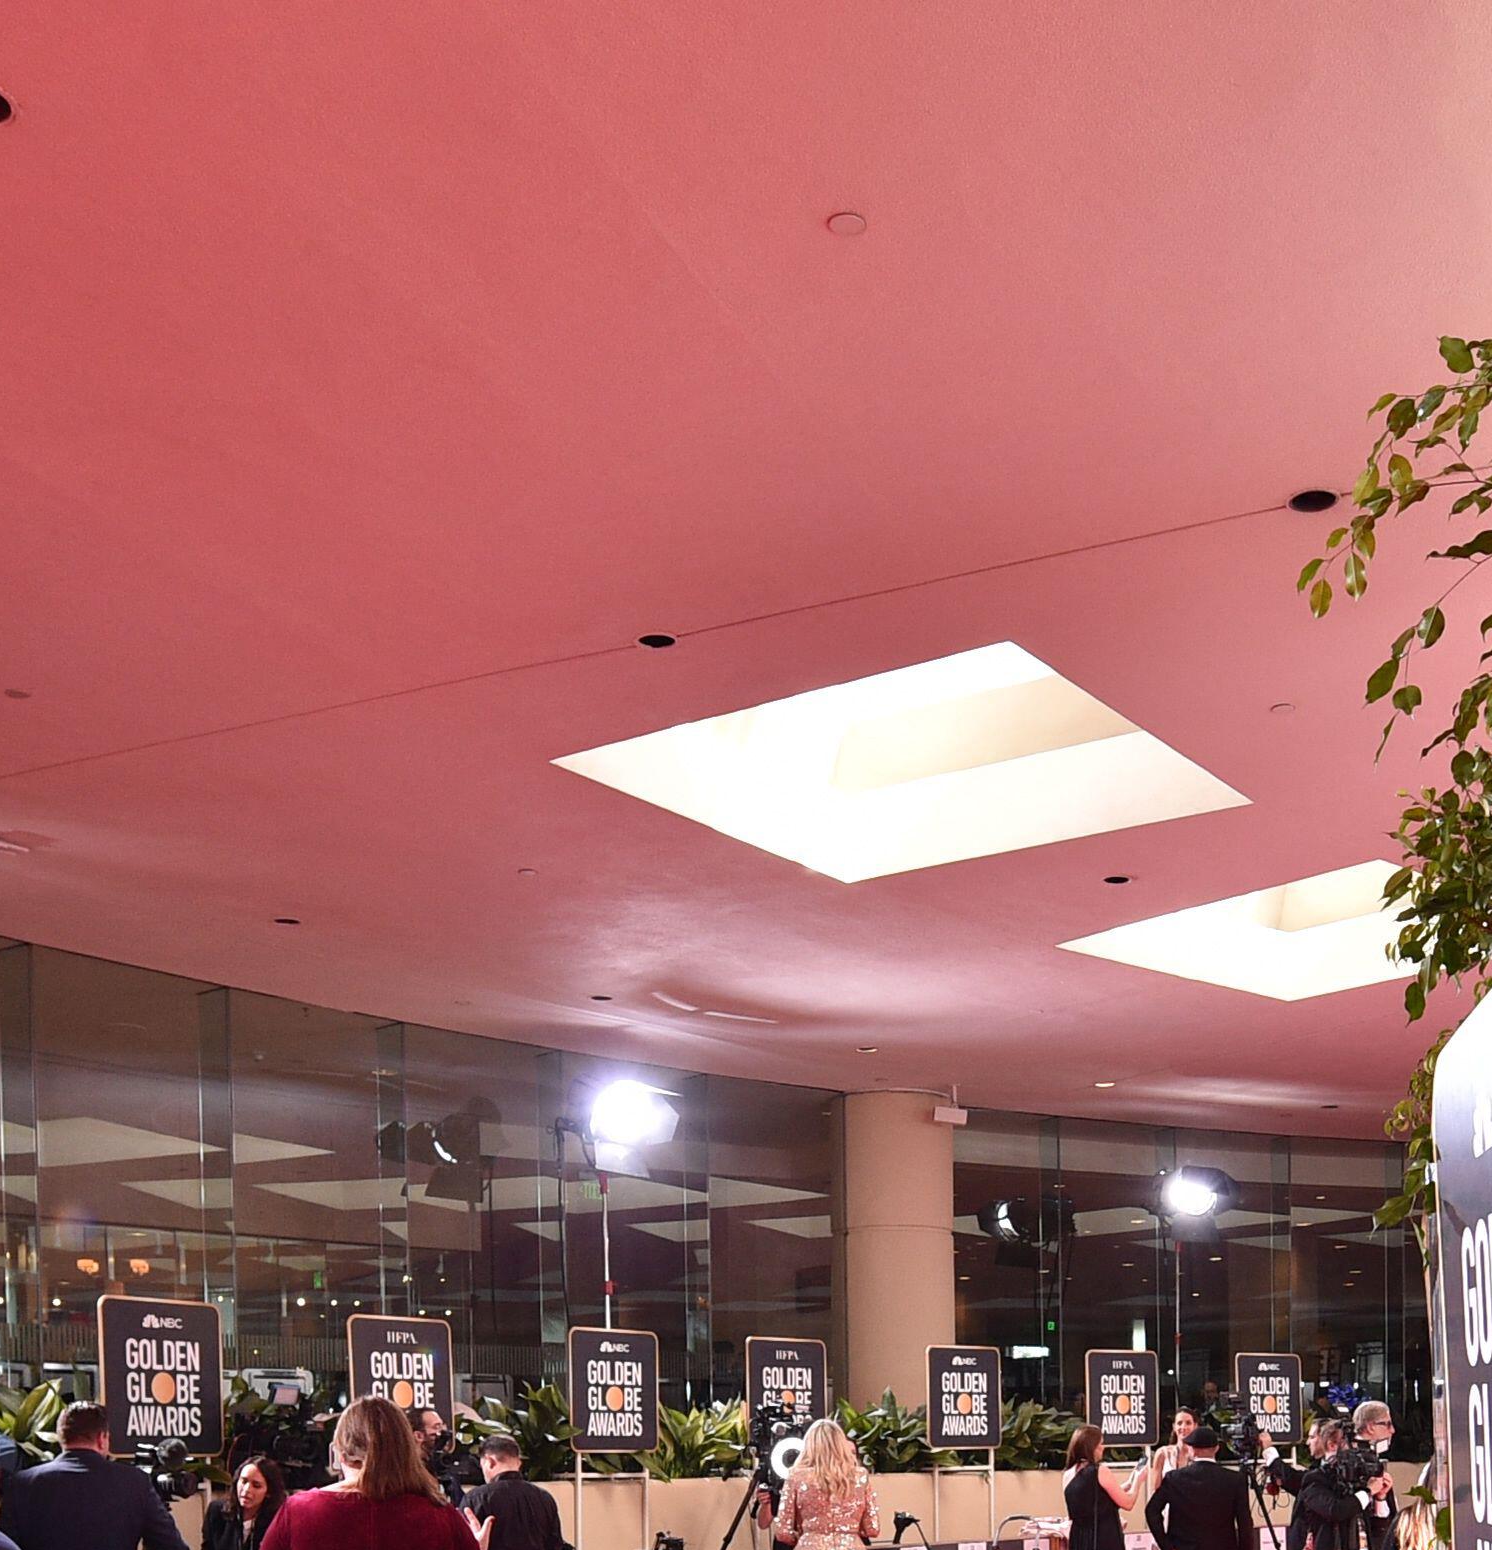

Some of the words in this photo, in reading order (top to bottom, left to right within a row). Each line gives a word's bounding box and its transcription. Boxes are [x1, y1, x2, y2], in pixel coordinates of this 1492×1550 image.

[159, 1317, 184, 1329] NBC
[125, 1337, 201, 1372] GOLDEN
[612, 1343, 631, 1353] NBC
[370, 1351, 435, 1381] GOLDEN
[586, 1359, 643, 1387] GOLDEN
[126, 1371, 202, 1405] GLOBE
[762, 1366, 813, 1390] GOLDEN
[941, 1371, 988, 1394] GOLDEN
[1100, 1374, 1146, 1395] GOLDEN
[1249, 1376, 1291, 1395] GOLDEN
[587, 1385, 643, 1412] GLOBE
[941, 1393, 989, 1416] GLOBE
[1100, 1394, 1147, 1415] GLOBE
[1249, 1394, 1291, 1414] GLOBE
[126, 1405, 203, 1438] AWARDS
[586, 1412, 644, 1438] AWARDS
[941, 1415, 989, 1437] AWARDS
[1100, 1415, 1147, 1435] AWARDS
[1255, 1414, 1292, 1433] WARDS
